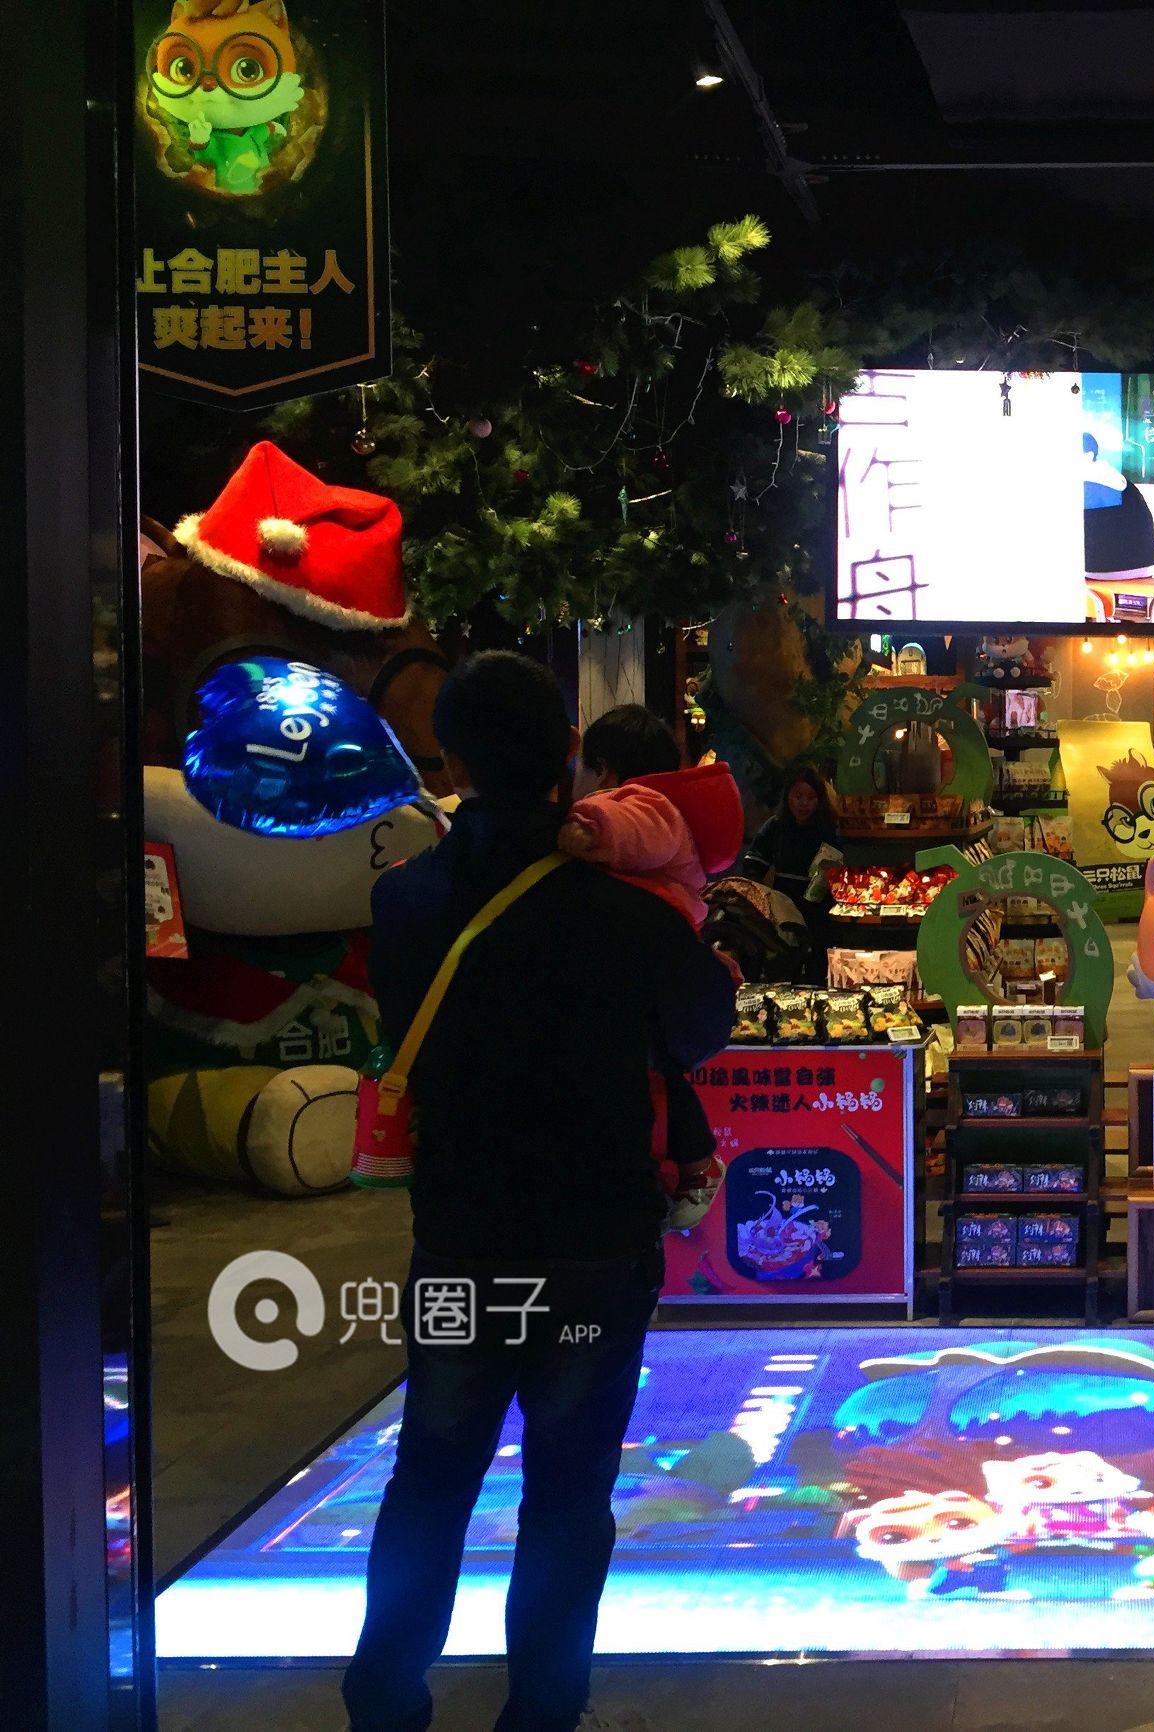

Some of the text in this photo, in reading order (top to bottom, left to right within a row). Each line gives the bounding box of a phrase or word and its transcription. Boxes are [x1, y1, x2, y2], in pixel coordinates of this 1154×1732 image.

[245, 661, 331, 763] Leyen
[1082, 864, 1143, 883] 三只松鼠
